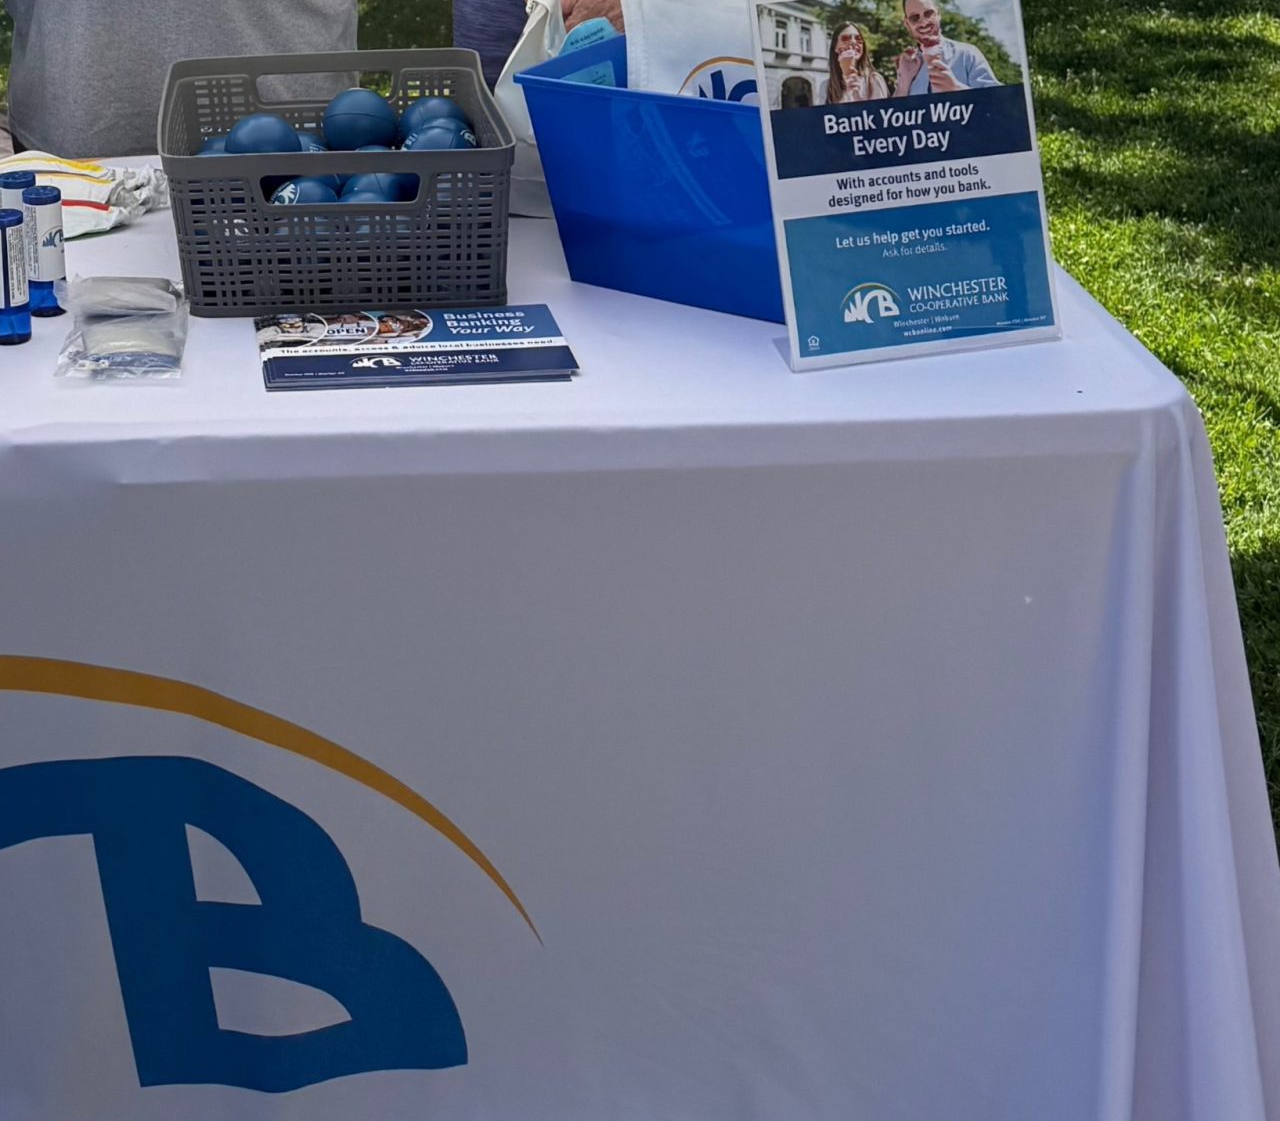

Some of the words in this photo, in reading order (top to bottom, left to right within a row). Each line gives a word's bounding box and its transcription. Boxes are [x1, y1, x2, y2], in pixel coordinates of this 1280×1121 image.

[824, 110, 877, 134] Bank
[880, 107, 926, 128] Your
[930, 101, 974, 124] Way
[853, 135, 907, 156] Every
[912, 129, 950, 151] Day
[837, 177, 865, 190] With
[868, 171, 921, 187] accounts
[924, 166, 946, 180] and
[949, 163, 979, 176] tools
[828, 190, 884, 208] designed
[886, 187, 903, 200] for
[906, 184, 931, 198] how
[933, 183, 956, 198] you
[958, 178, 991, 192] bank.
[836, 237, 854, 248] Let
[856, 235, 871, 247] us
[873, 230, 899, 245] help
[901, 229, 921, 245] get
[922, 227, 943, 241] you
[945, 219, 991, 236] started.
[882, 248, 900, 258] Ask
[900, 245, 913, 256] for
[907, 276, 1008, 301] WINCHESTER
[909, 295, 979, 313] CO-OPERATIVE
[982, 291, 1009, 304] BANK
[443, 311, 525, 321] Business
[446, 318, 522, 328] Banking
[327, 327, 368, 336] OPEN
[449, 326, 491, 335] Your
[495, 324, 535, 335] Way
[438, 342, 464, 350] local
[409, 354, 499, 362] WINCHESTER
